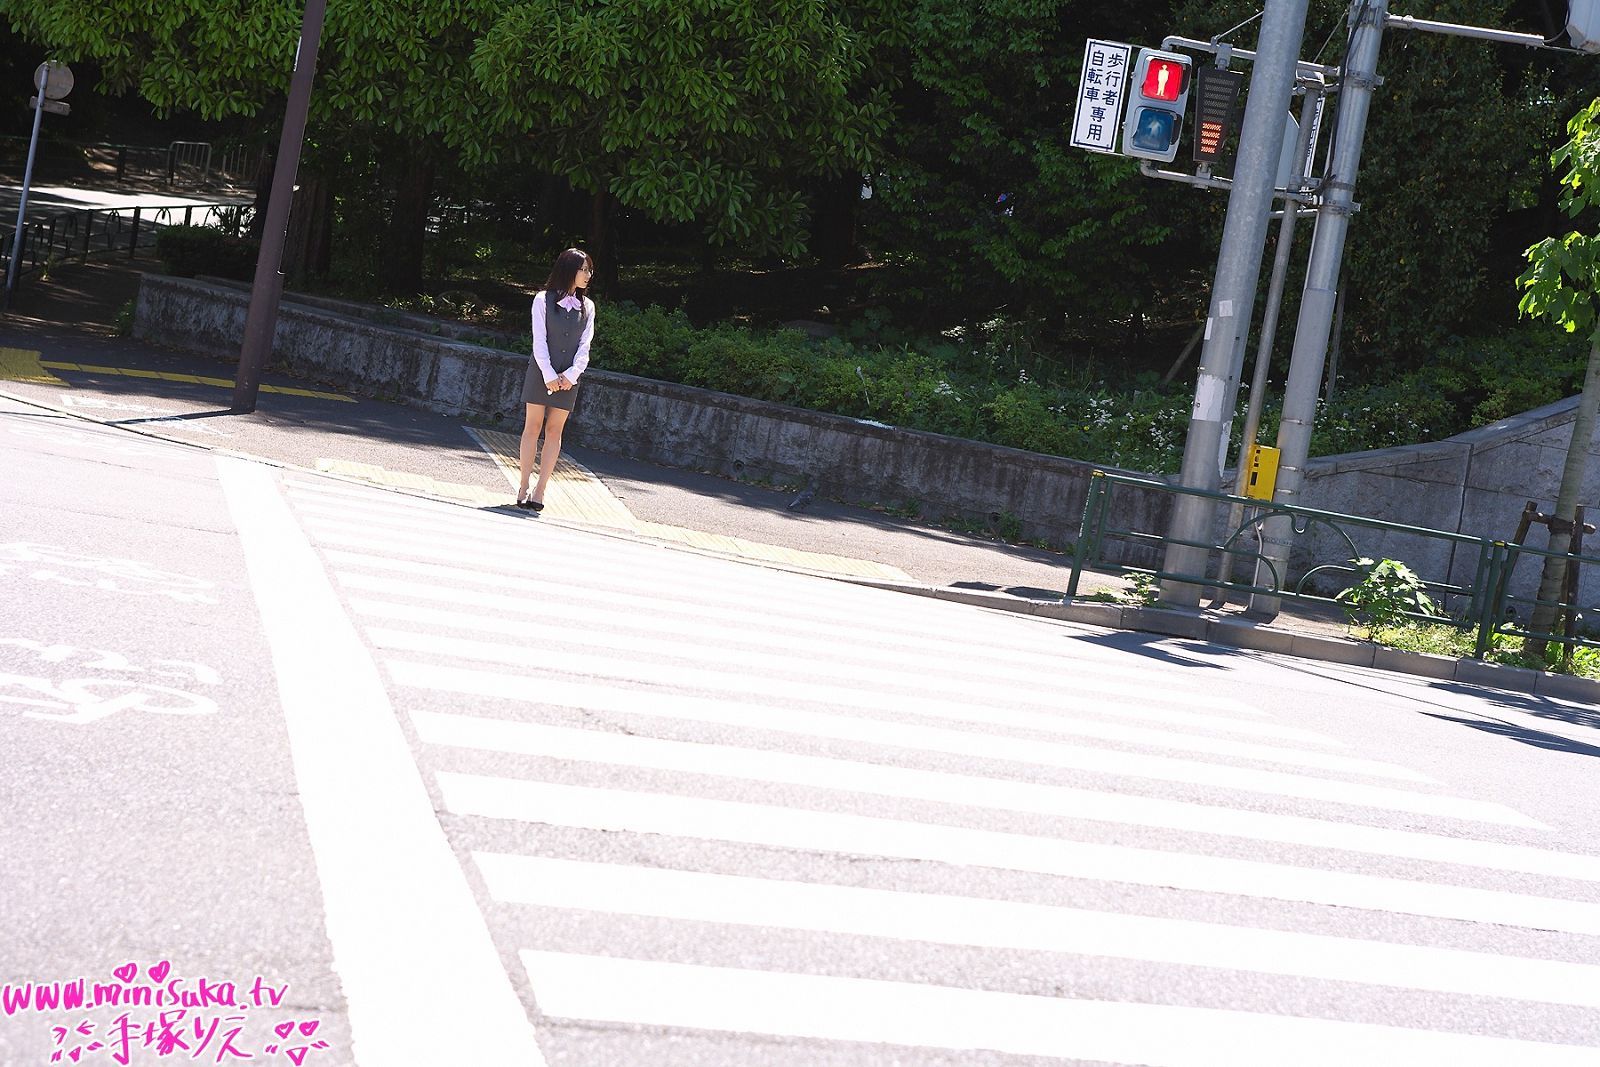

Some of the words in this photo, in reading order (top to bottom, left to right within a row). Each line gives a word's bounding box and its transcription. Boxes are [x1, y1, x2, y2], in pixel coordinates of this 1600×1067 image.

[1084, 50, 1104, 102] 自転車
[1102, 53, 1123, 106] 歩行者
[1086, 106, 1106, 141] 専用
